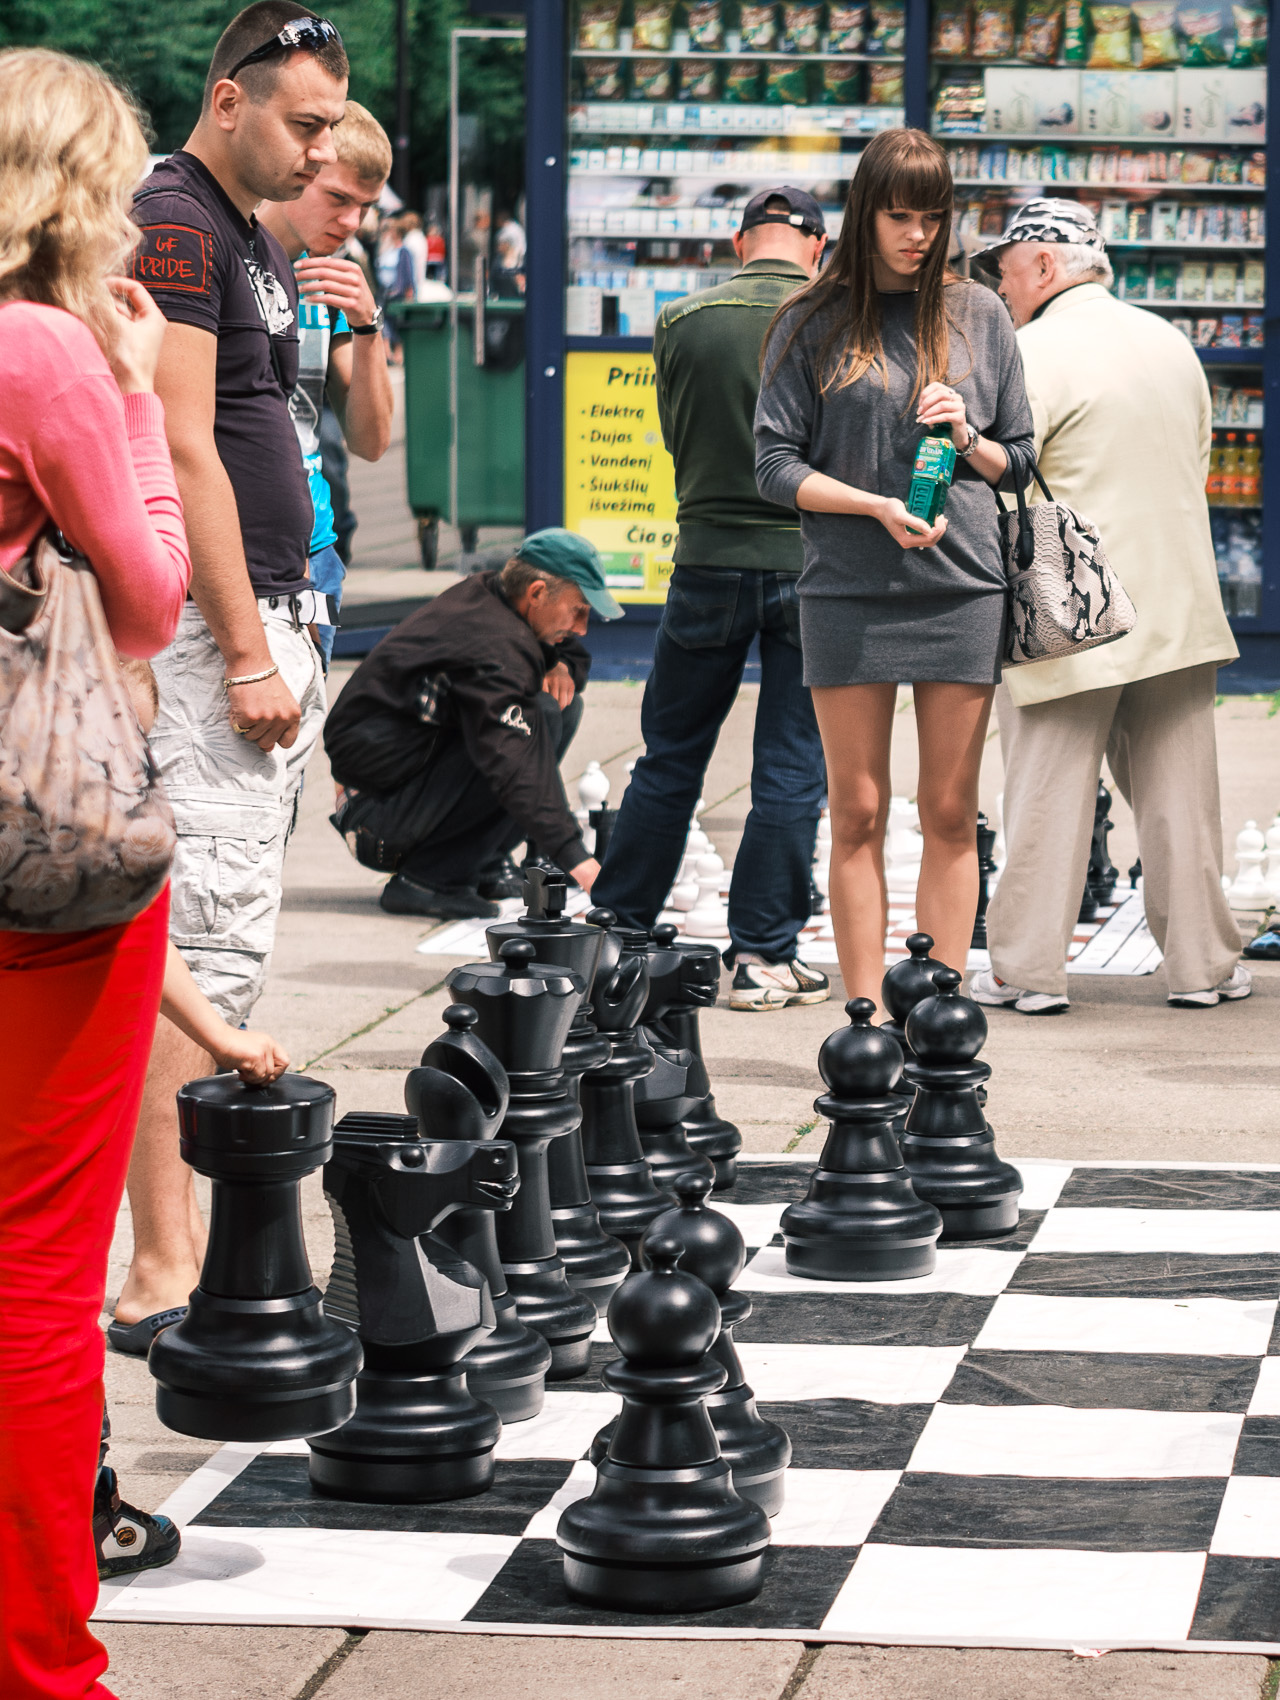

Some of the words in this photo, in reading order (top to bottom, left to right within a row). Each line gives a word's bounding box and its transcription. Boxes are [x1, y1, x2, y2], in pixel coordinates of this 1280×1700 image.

[140, 255, 196, 279] PRIDE
[590, 429, 633, 447] Dujas
[626, 524, 656, 544] Čia
